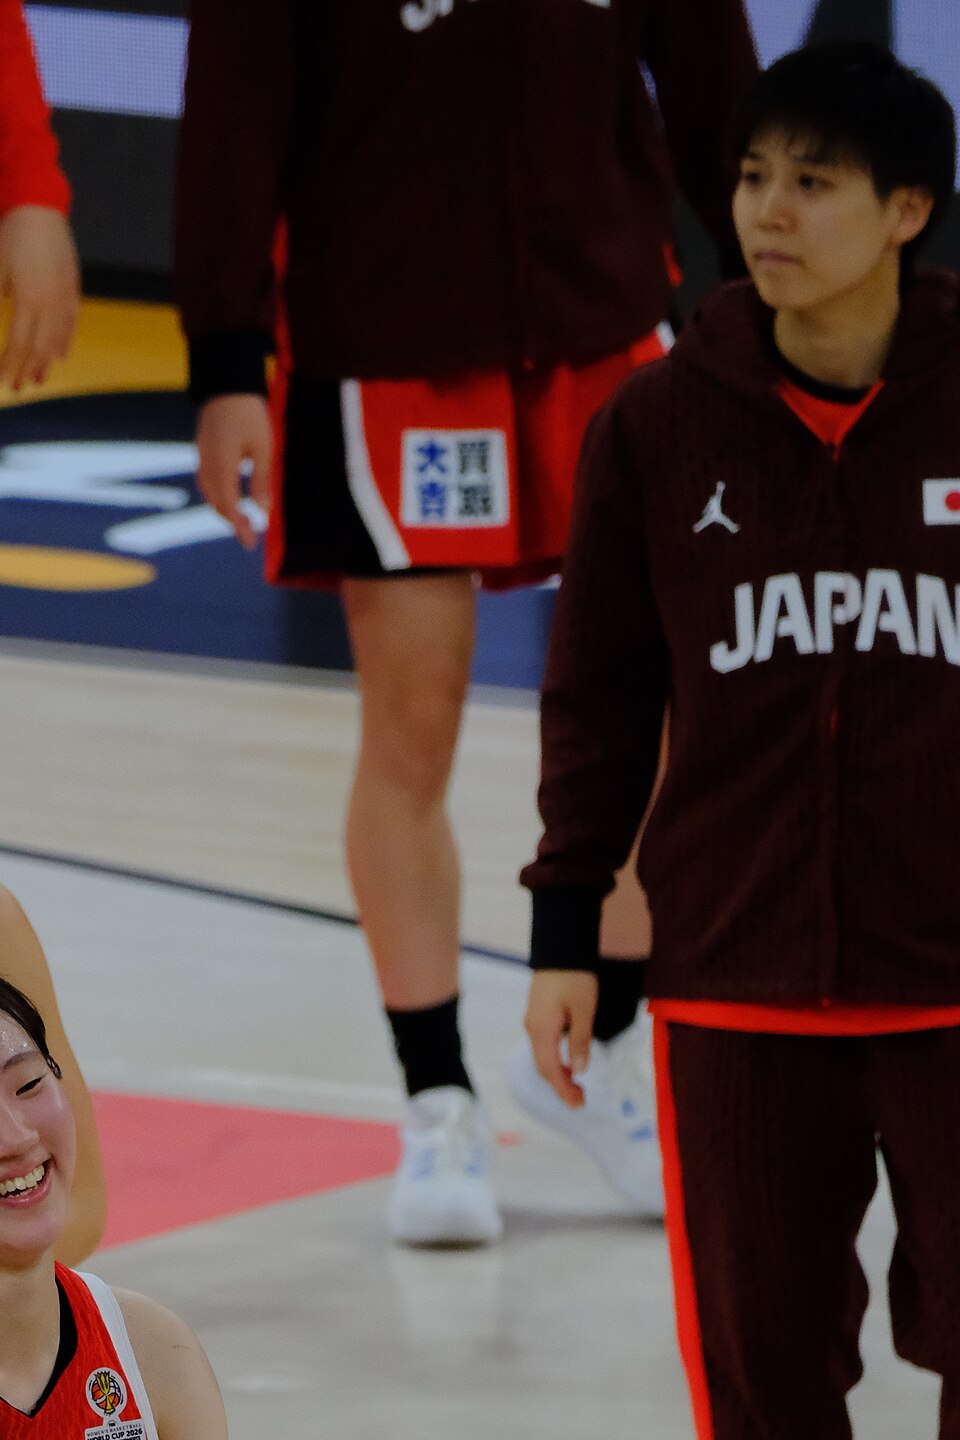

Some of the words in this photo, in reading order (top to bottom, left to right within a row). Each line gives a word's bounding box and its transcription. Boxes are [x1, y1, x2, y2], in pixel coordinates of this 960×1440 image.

[709, 567, 960, 674] JAPAN
[111, 1432, 125, 1440] CUP
[126, 1428, 143, 1437] 2026
